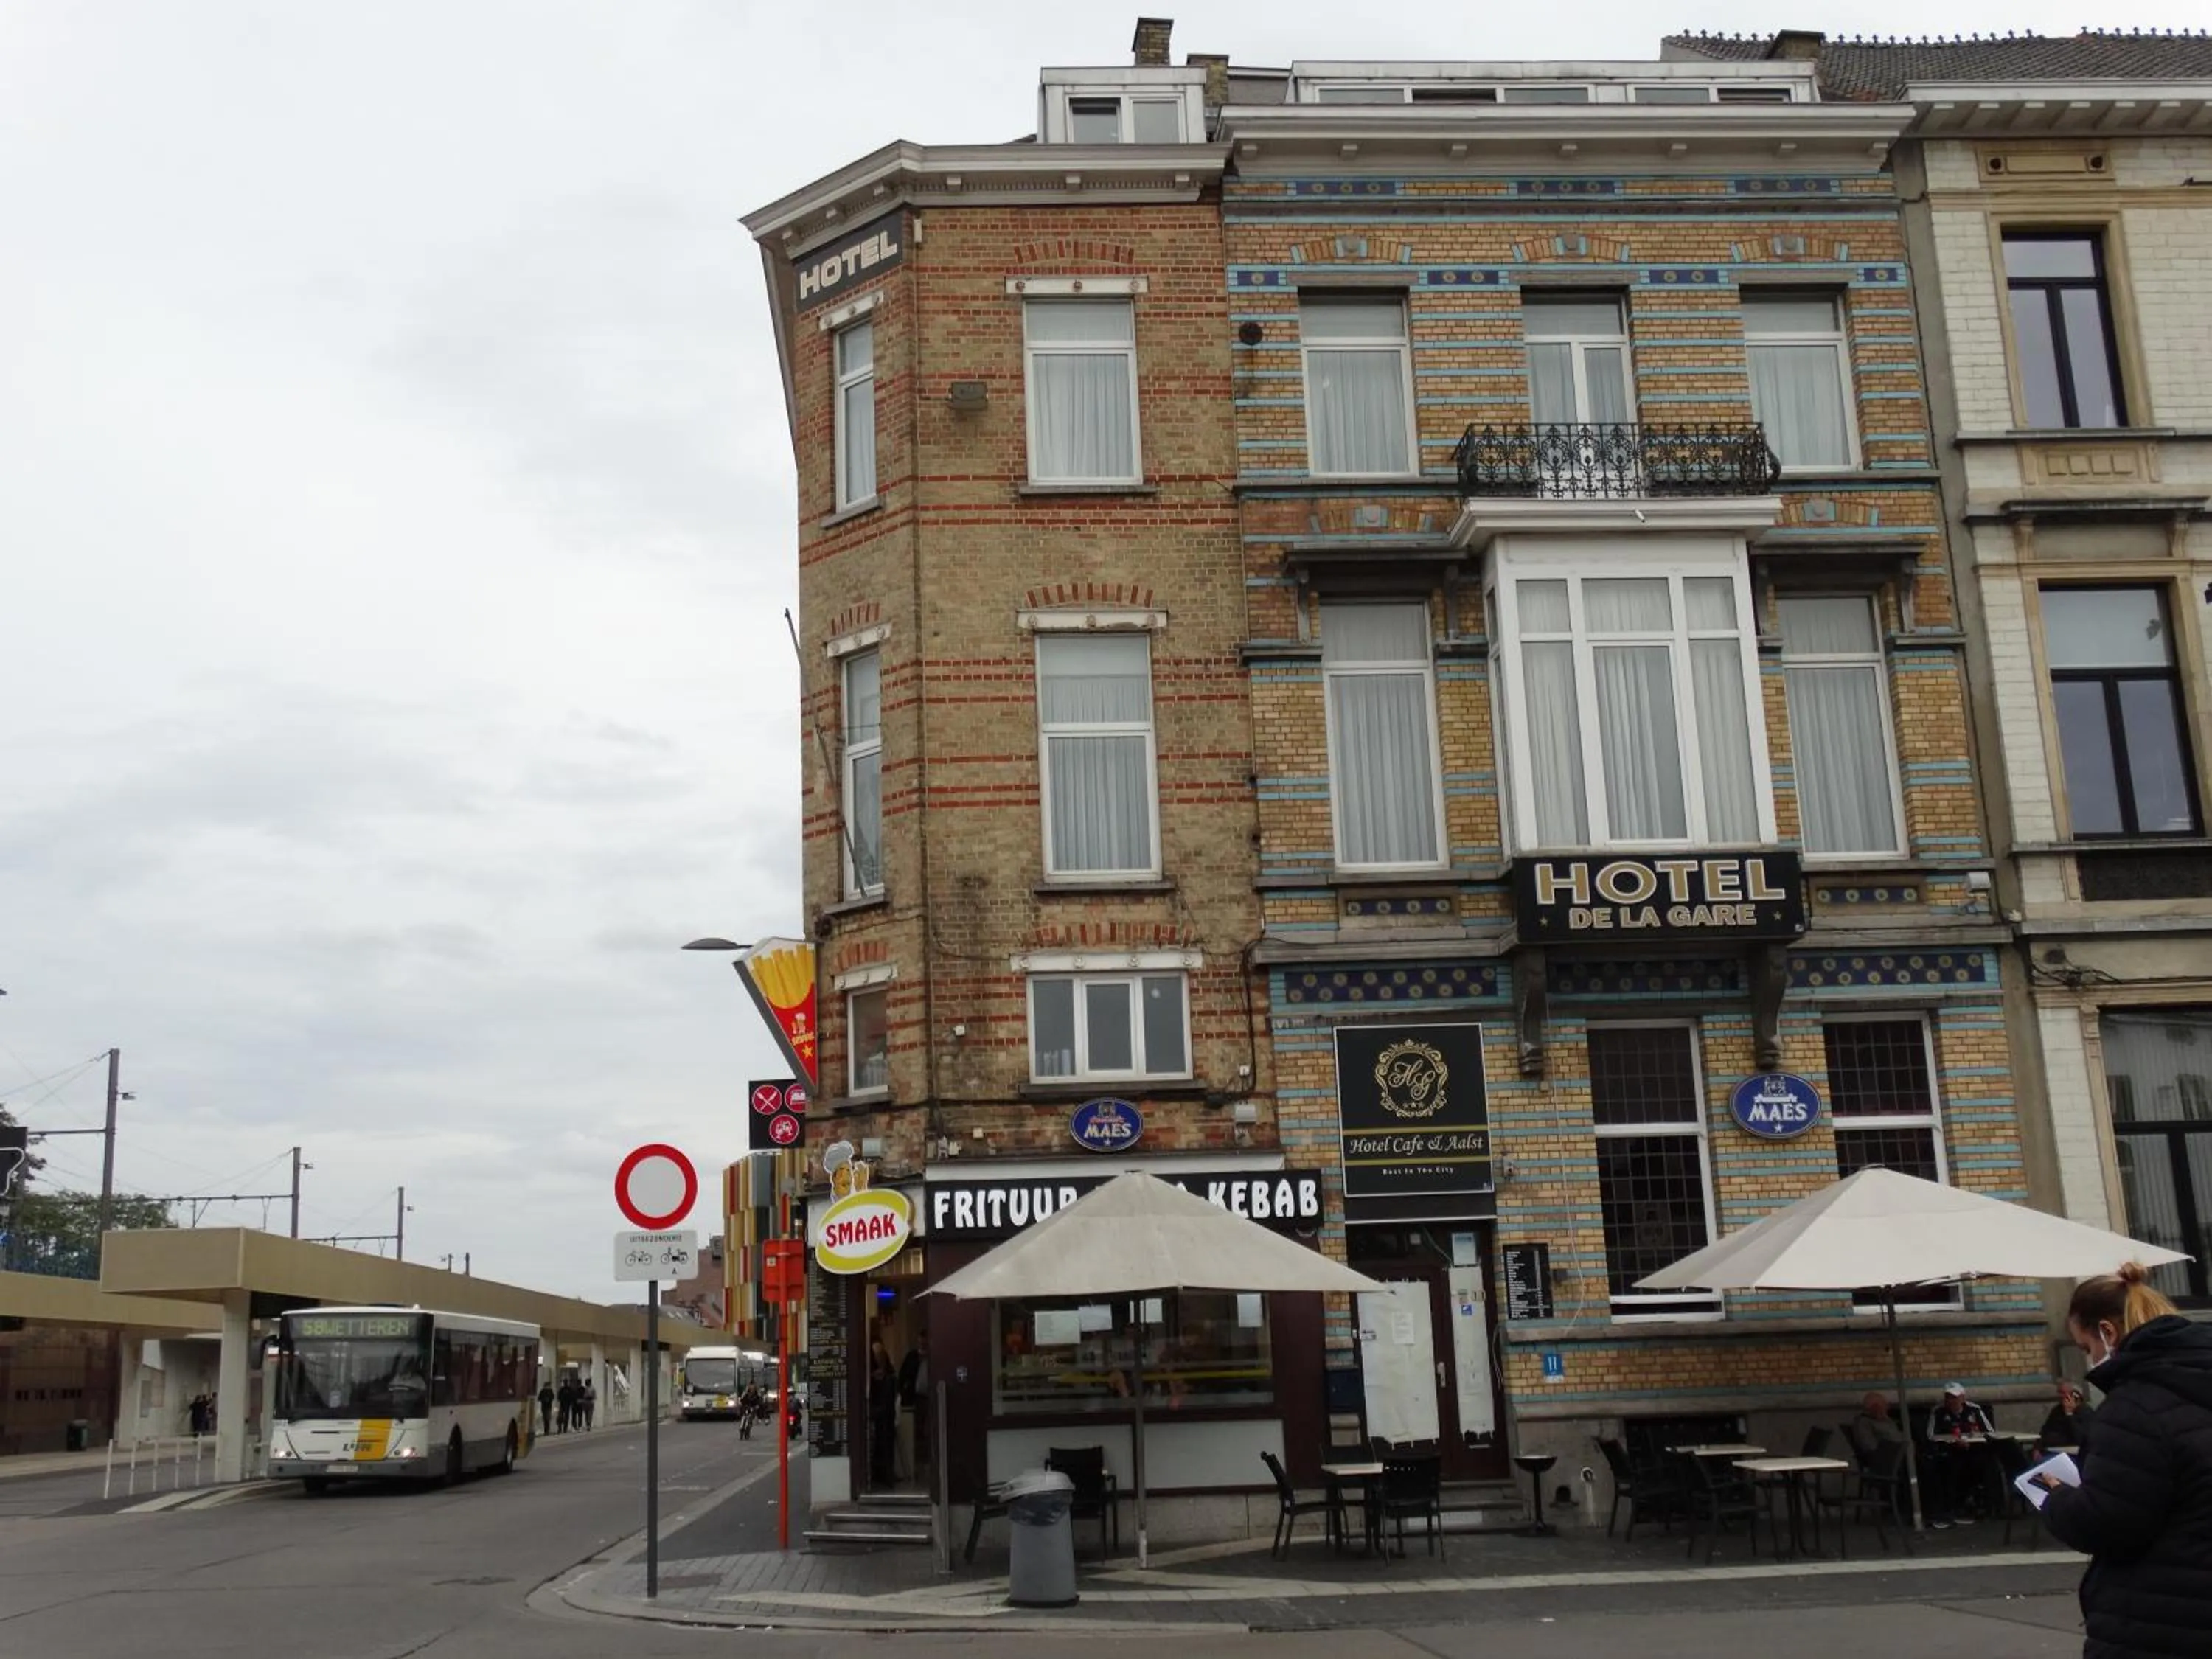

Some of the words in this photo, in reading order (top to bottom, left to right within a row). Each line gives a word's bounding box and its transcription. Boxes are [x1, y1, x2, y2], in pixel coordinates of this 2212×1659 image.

[800, 230, 897, 300] HOTEL
[1534, 859, 1787, 905] HOTEL
[1569, 908, 1613, 929] DE
[1618, 906, 1661, 928] LA
[1666, 904, 1757, 927] GARE
[1747, 1102, 1809, 1121] MAES
[1083, 1121, 1133, 1139] MAES
[1349, 1136, 1392, 1154] Hotel
[1392, 1134, 1424, 1155] Cafe
[1427, 1134, 1443, 1151] &
[1444, 1133, 1484, 1151] Aalst
[1208, 1178, 1319, 1218] KEBAB
[825, 1212, 897, 1248] SMAAK
